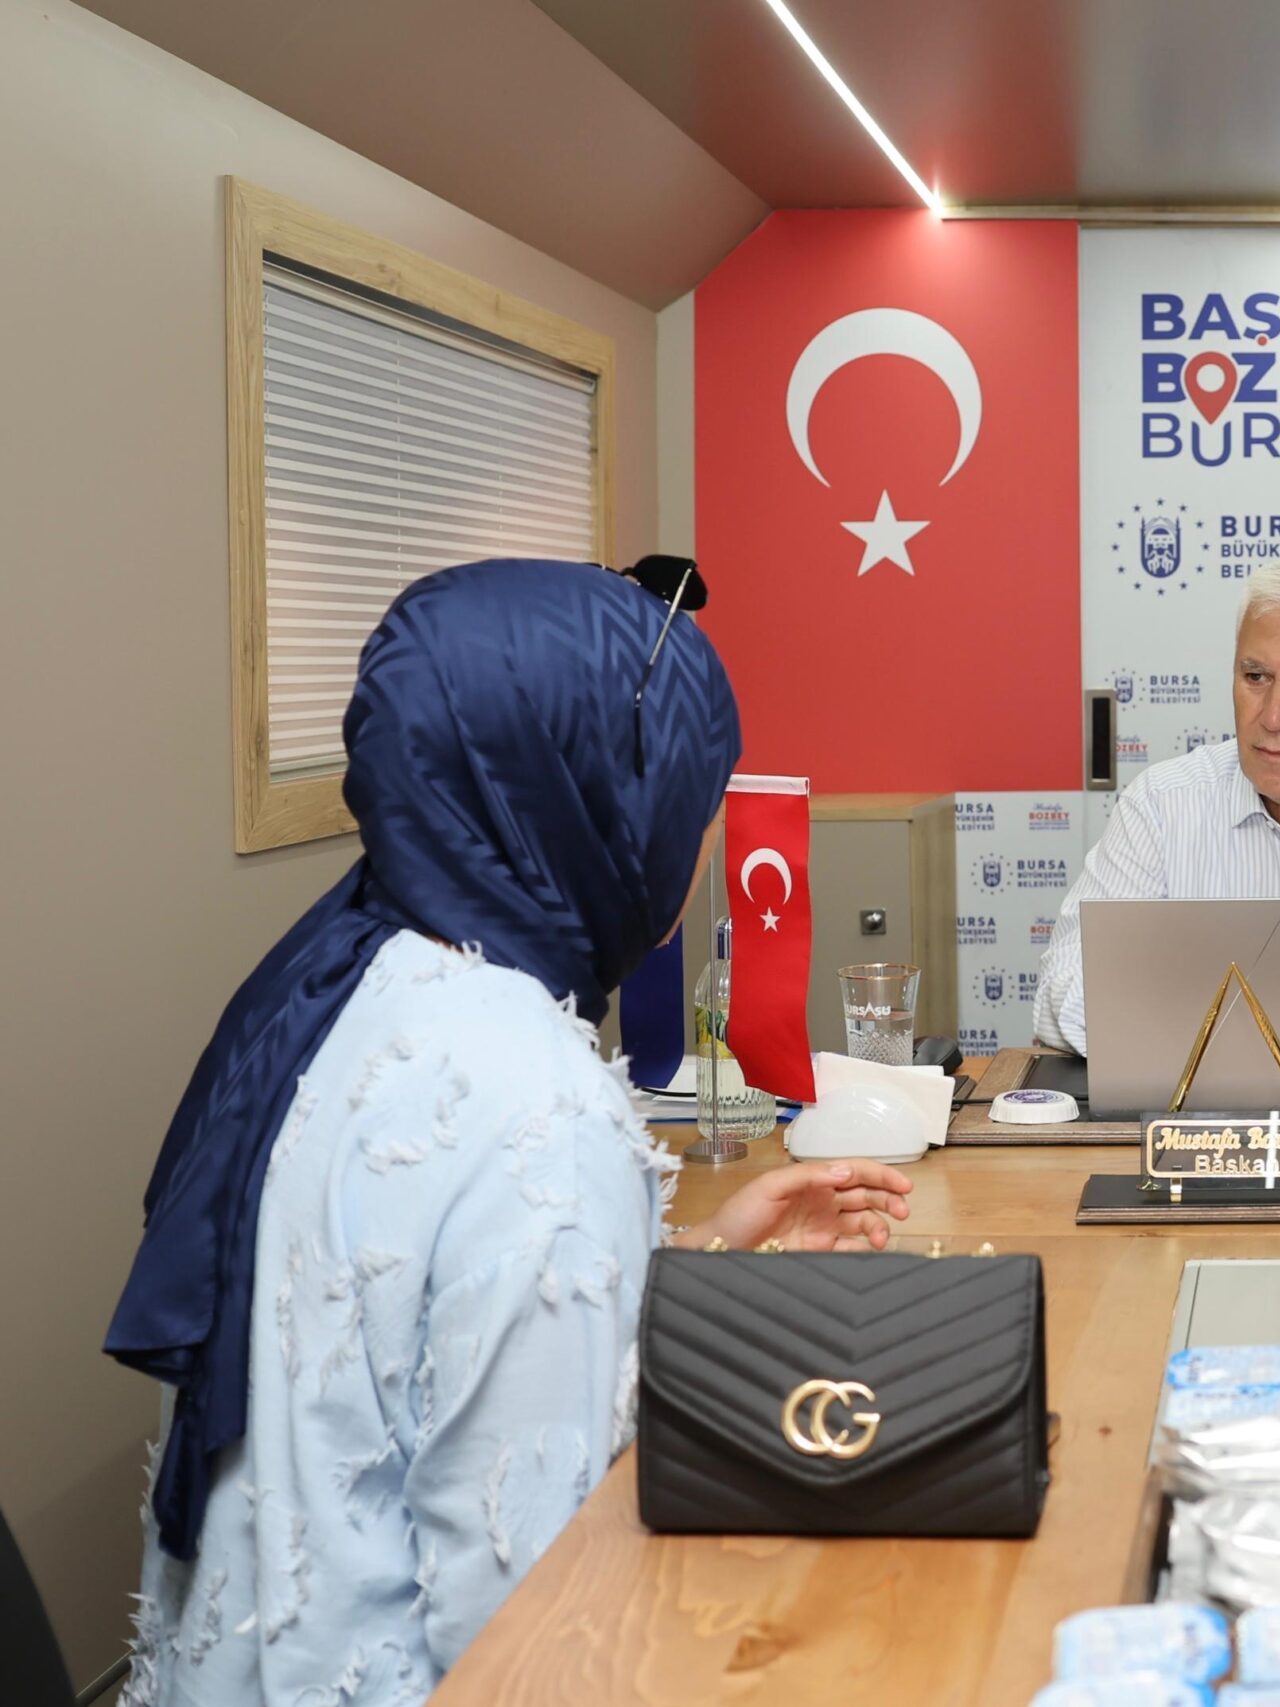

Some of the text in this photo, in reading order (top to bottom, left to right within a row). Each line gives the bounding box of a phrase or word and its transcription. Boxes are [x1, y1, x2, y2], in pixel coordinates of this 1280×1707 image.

[1150, 675, 1200, 685] BURSA
[1115, 744, 1148, 752] OZBEY
[955, 803, 995, 813] URSA
[1029, 812, 1070, 820] BOZBEY
[1017, 860, 1067, 870] BURSA
[957, 916, 997, 927] URSA
[959, 1030, 998, 1040] URSA
[1155, 1127, 1241, 1159] Mustafa
